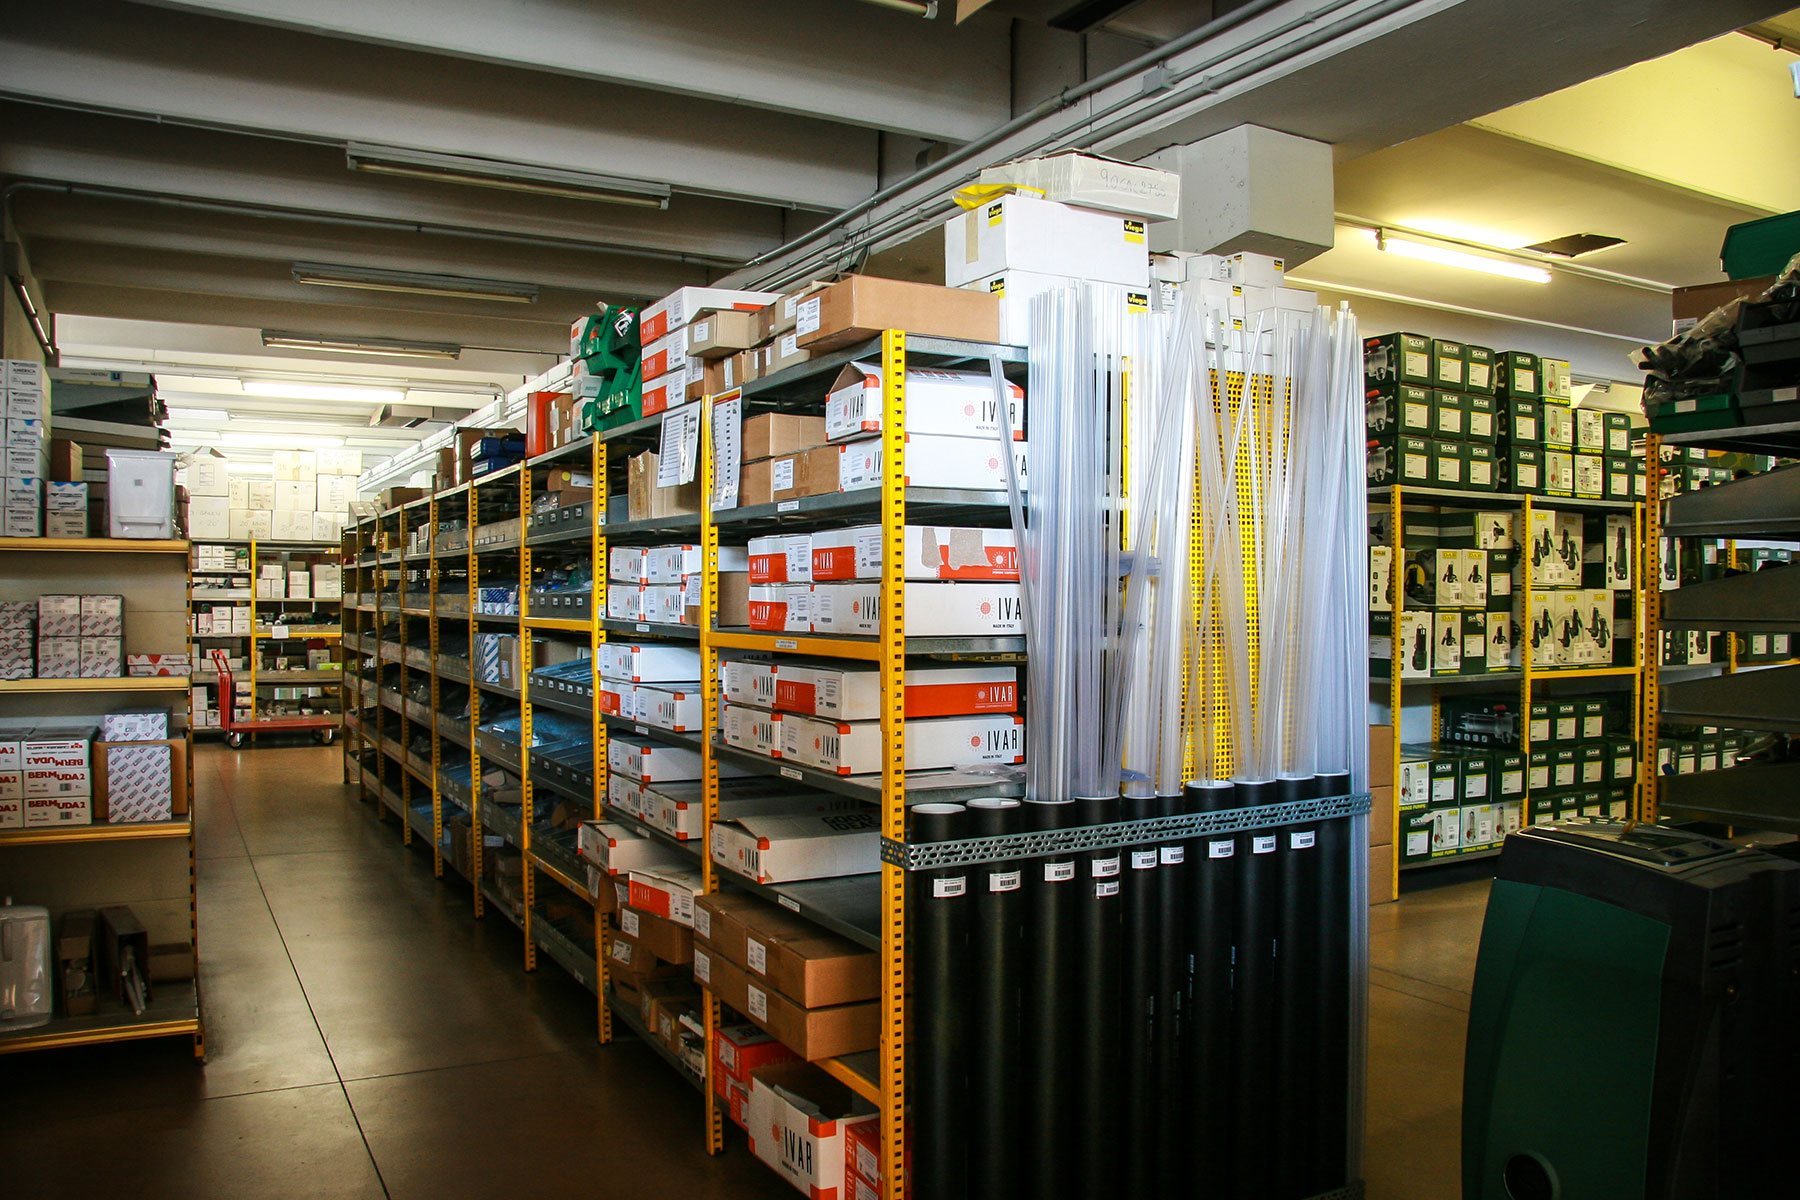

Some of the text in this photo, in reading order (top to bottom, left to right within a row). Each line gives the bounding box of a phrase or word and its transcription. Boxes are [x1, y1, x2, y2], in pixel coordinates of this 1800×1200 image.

[989, 206, 1002, 217] Viega
[1124, 221, 1143, 233] Viega
[990, 281, 1004, 292] Viega
[1128, 295, 1147, 306] Viega
[1408, 339, 1424, 347] DAB
[1443, 344, 1459, 352] DAB
[1408, 390, 1424, 398] DAB
[849, 393, 864, 419] IVAR
[982, 401, 1016, 424] IVR
[820, 552, 833, 569] IVAR
[998, 597, 1022, 620] IVA
[759, 675, 773, 697] IVAR
[990, 685, 1013, 703] IVAR
[759, 722, 773, 744] IVAR
[988, 729, 1017, 751] IVAR
[822, 735, 839, 760] IVAR
[32, 757, 84, 767] BERMUDA
[28, 771, 79, 781] BERMUDA
[28, 800, 80, 809] BERMUDA
[822, 814, 873, 825] GOOD
[829, 821, 882, 832] IDEAS
[744, 847, 758, 872] IVAR
[785, 1126, 812, 1175] IVAR
